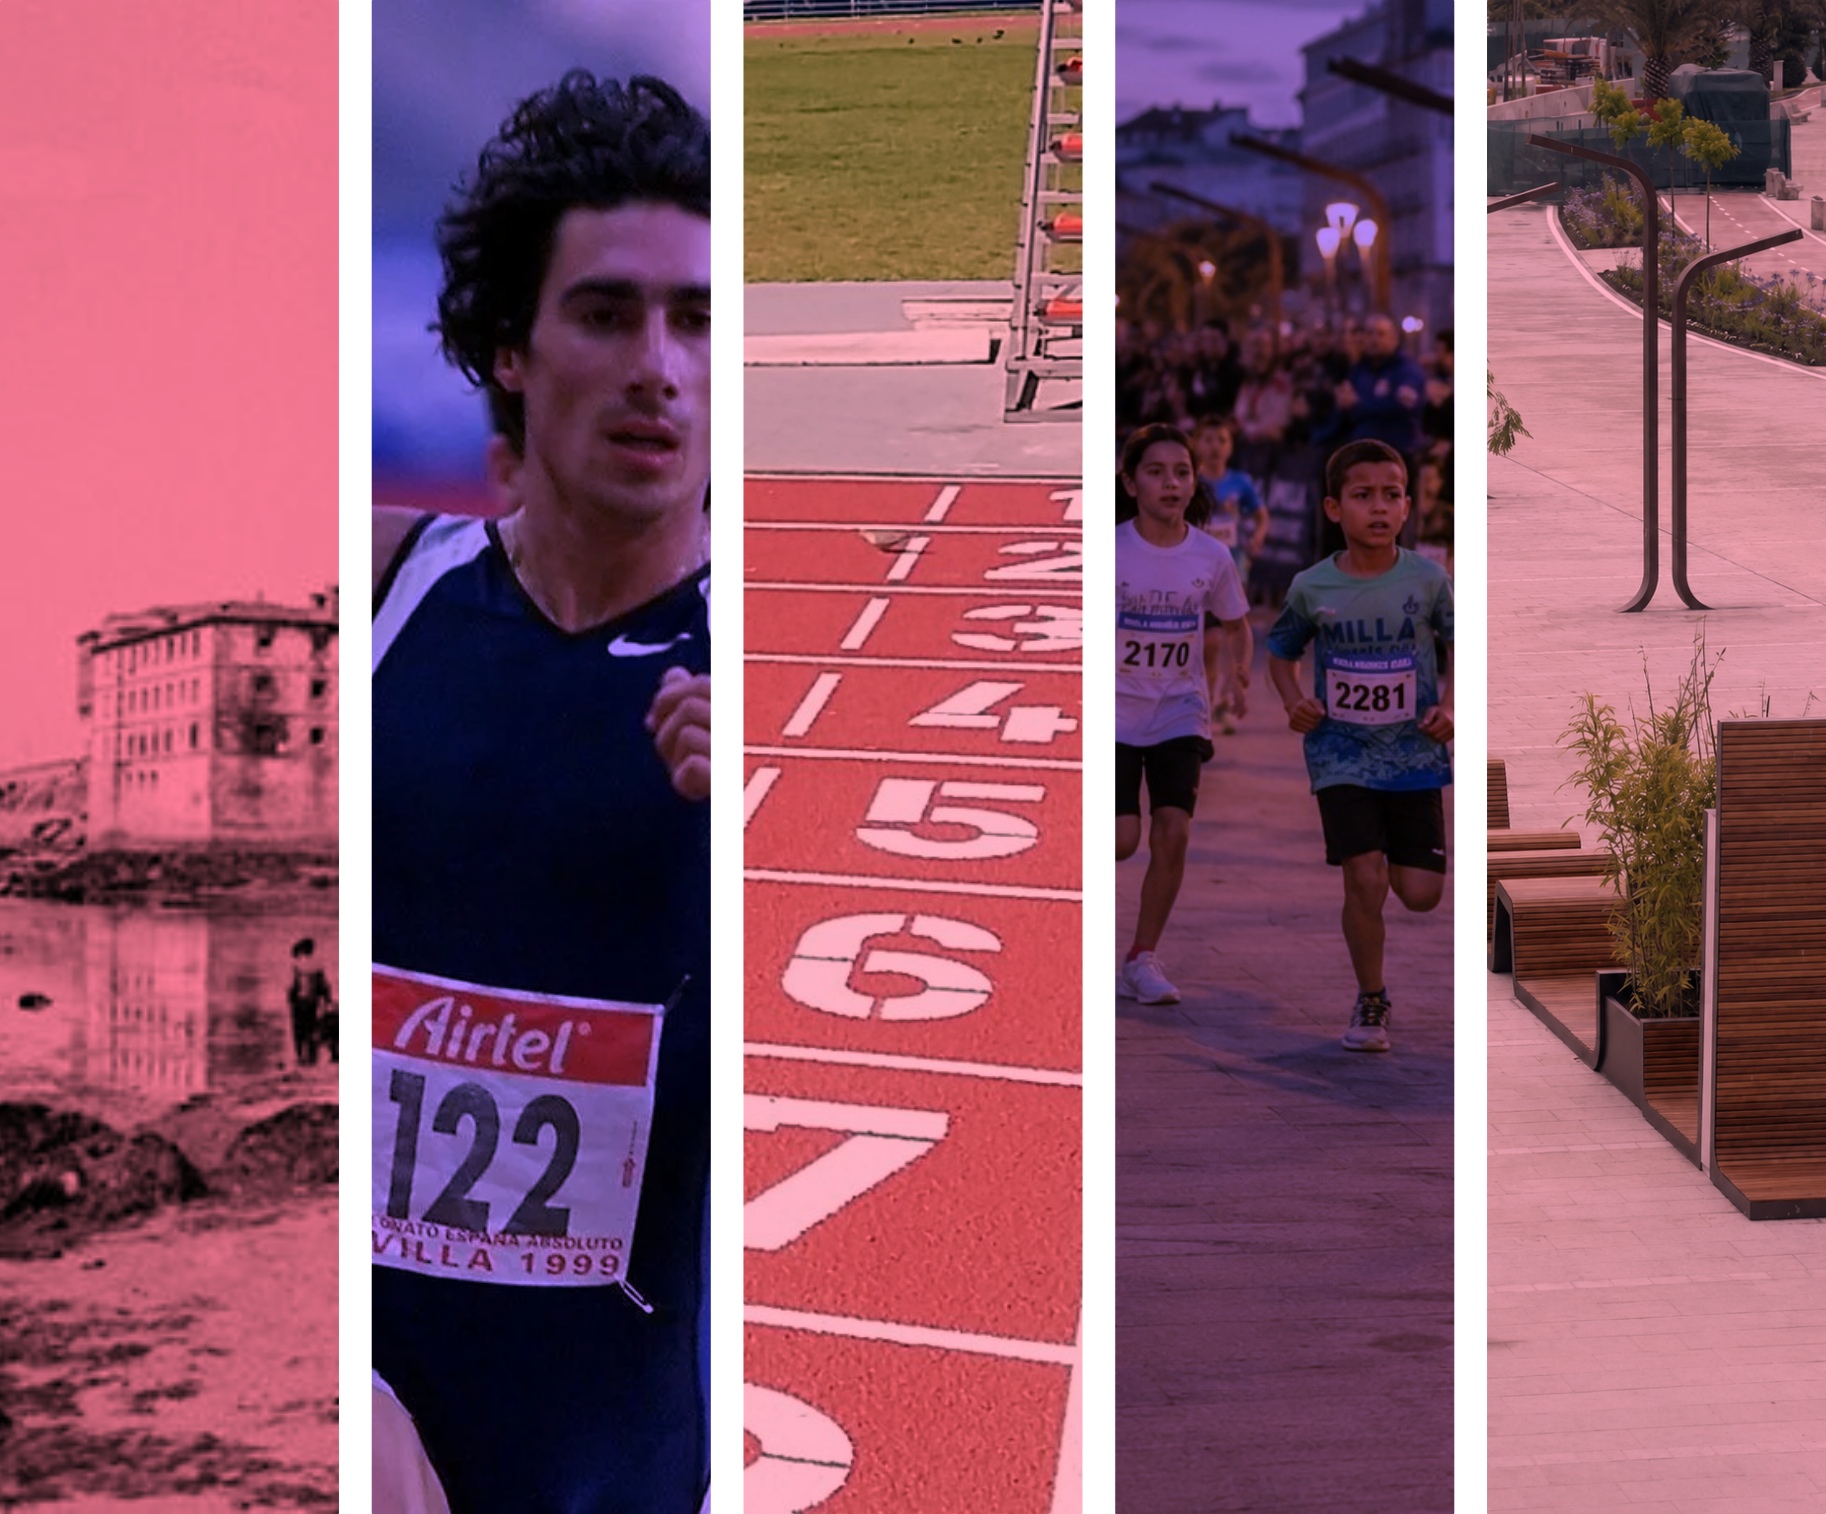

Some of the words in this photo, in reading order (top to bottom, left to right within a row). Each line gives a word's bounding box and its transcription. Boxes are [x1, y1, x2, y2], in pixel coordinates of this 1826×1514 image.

[983, 540, 1083, 580] 2
[950, 604, 1083, 652] 3
[1322, 617, 1415, 643] MILLA
[1123, 640, 1190, 668] 2170
[908, 680, 1078, 743] 4
[1335, 681, 1405, 712] 2281
[855, 776, 1046, 860] 5
[780, 912, 1002, 1021] 6
[387, 1068, 580, 1237] 122
[744, 1094, 950, 1252] 7
[520, 1252, 619, 1275] 1999
